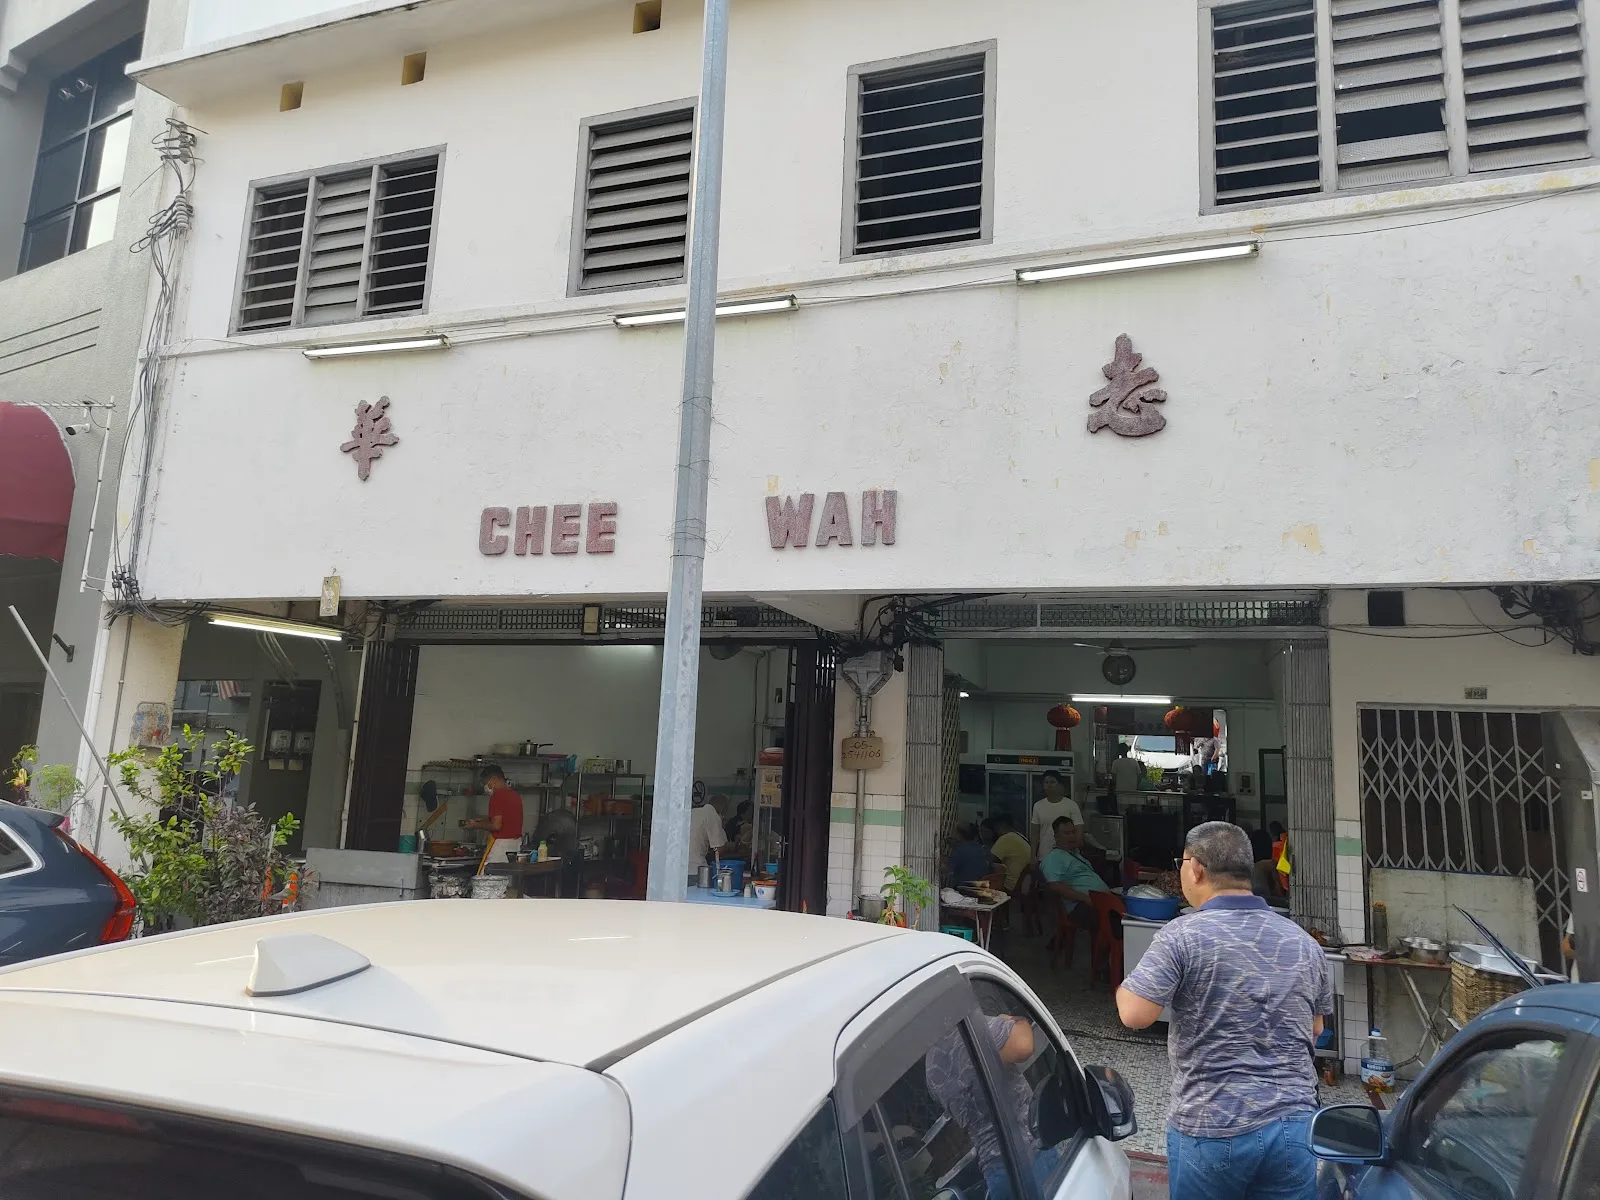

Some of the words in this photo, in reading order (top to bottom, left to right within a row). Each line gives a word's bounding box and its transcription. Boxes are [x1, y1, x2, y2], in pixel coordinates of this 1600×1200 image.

[339, 395, 400, 482] 華
[479, 502, 618, 557] CHEE
[765, 490, 898, 549] WAH
